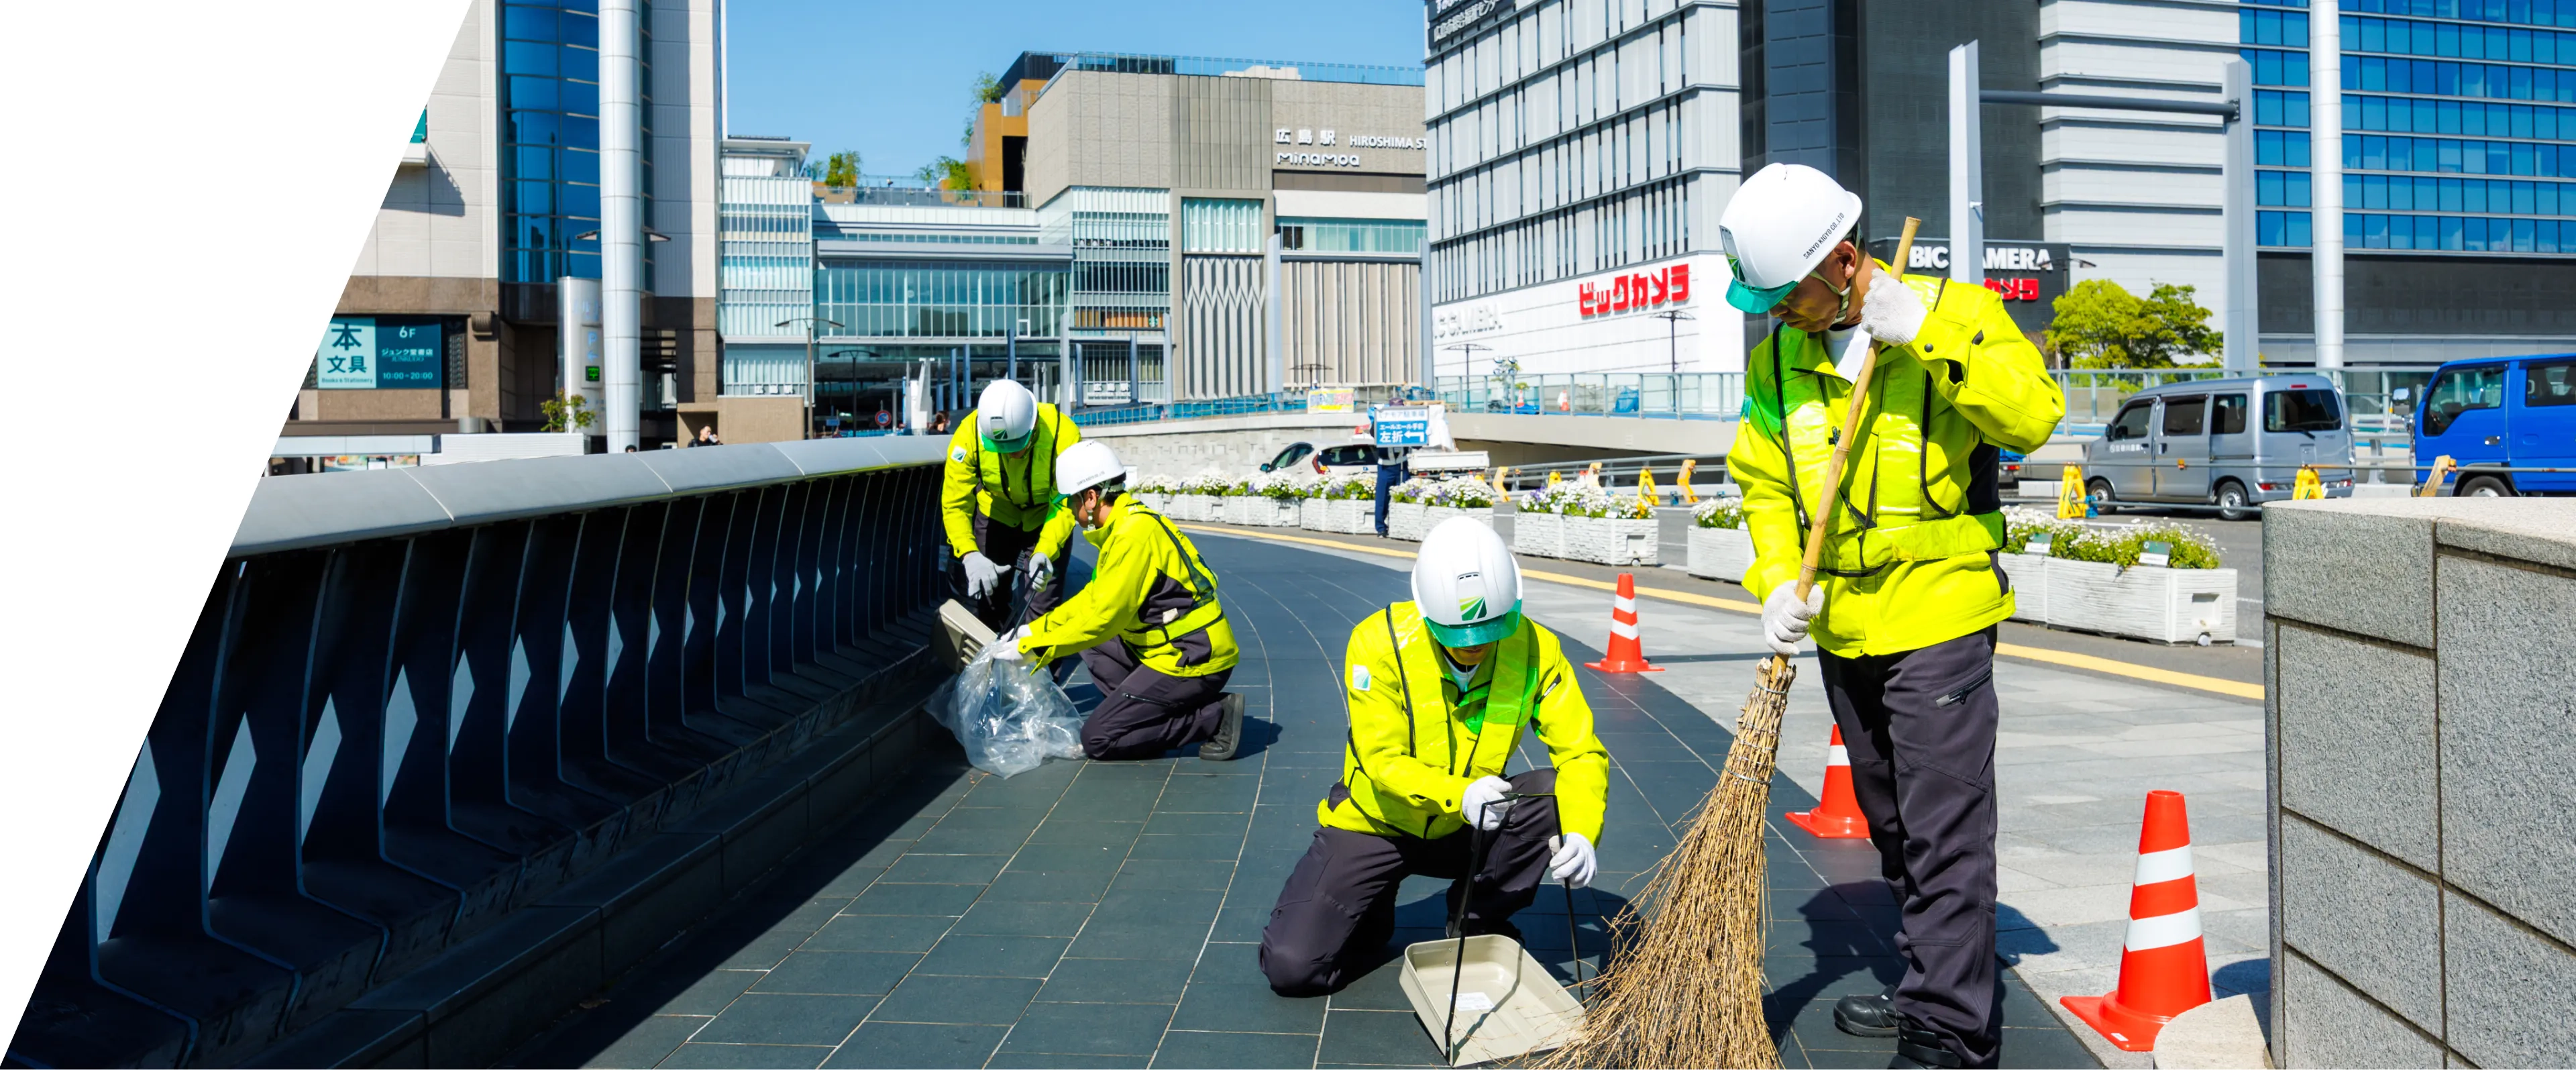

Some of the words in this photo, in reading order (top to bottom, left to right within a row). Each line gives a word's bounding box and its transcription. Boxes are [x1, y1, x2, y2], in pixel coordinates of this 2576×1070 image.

[1275, 129, 1336, 145] 広島駅
[1350, 135, 1413, 149] HIROSHIMA
[1416, 138, 1427, 150] ST
[1803, 242, 1820, 259] SANYO
[1818, 228, 1832, 244] KIGYO
[1909, 246, 1949, 268] BIC
[1983, 248, 2053, 270] MERA
[1579, 264, 1688, 317] ビックカメラ
[1984, 278, 2039, 300] カメラ
[331, 323, 362, 351] 本
[399, 327, 416, 338] 6F
[588, 331, 597, 345] P
[327, 355, 367, 374] 文具
[1379, 431, 1403, 443] 左折
